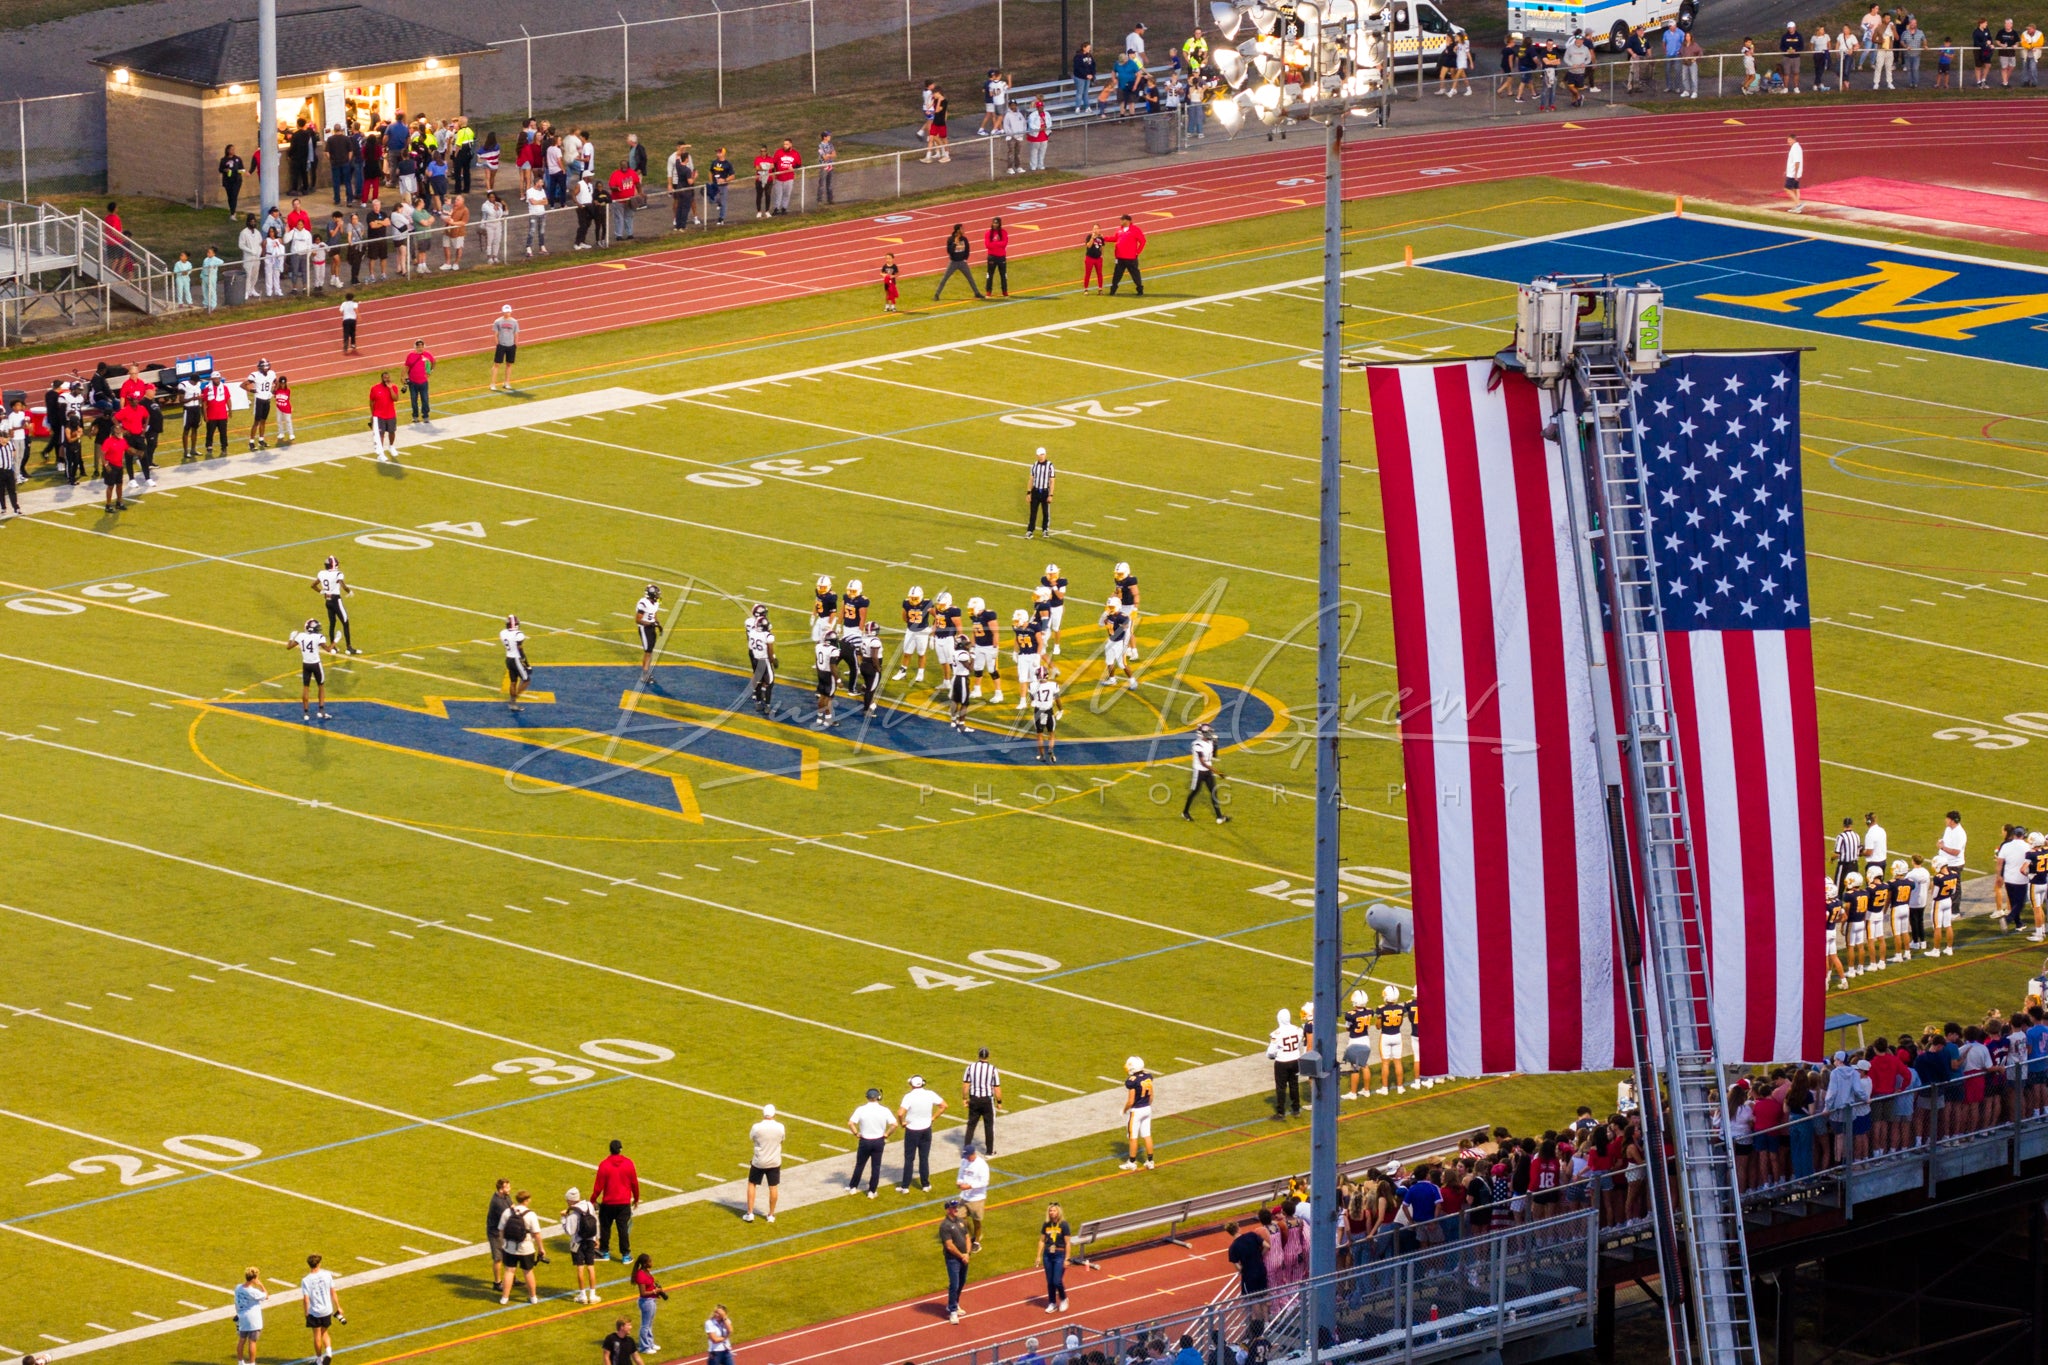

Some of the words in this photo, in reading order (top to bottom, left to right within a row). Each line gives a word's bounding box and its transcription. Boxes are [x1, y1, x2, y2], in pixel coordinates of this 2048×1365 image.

[261, 382, 270, 391] 18
[1000, 400, 1142, 428] 20
[685, 458, 833, 488] 30
[354, 521, 486, 550] 40
[323, 579, 330, 591] 9
[5, 583, 170, 615] 50
[301, 640, 313, 652] 14
[1037, 690, 1049, 702] 17
[908, 949, 1061, 991] 40
[1384, 1010, 1402, 1026] 36
[1283, 1035, 1298, 1052] 52
[491, 1038, 675, 1085] 30
[68, 1135, 262, 1185] 20
[1539, 1172, 1555, 1188] 18
